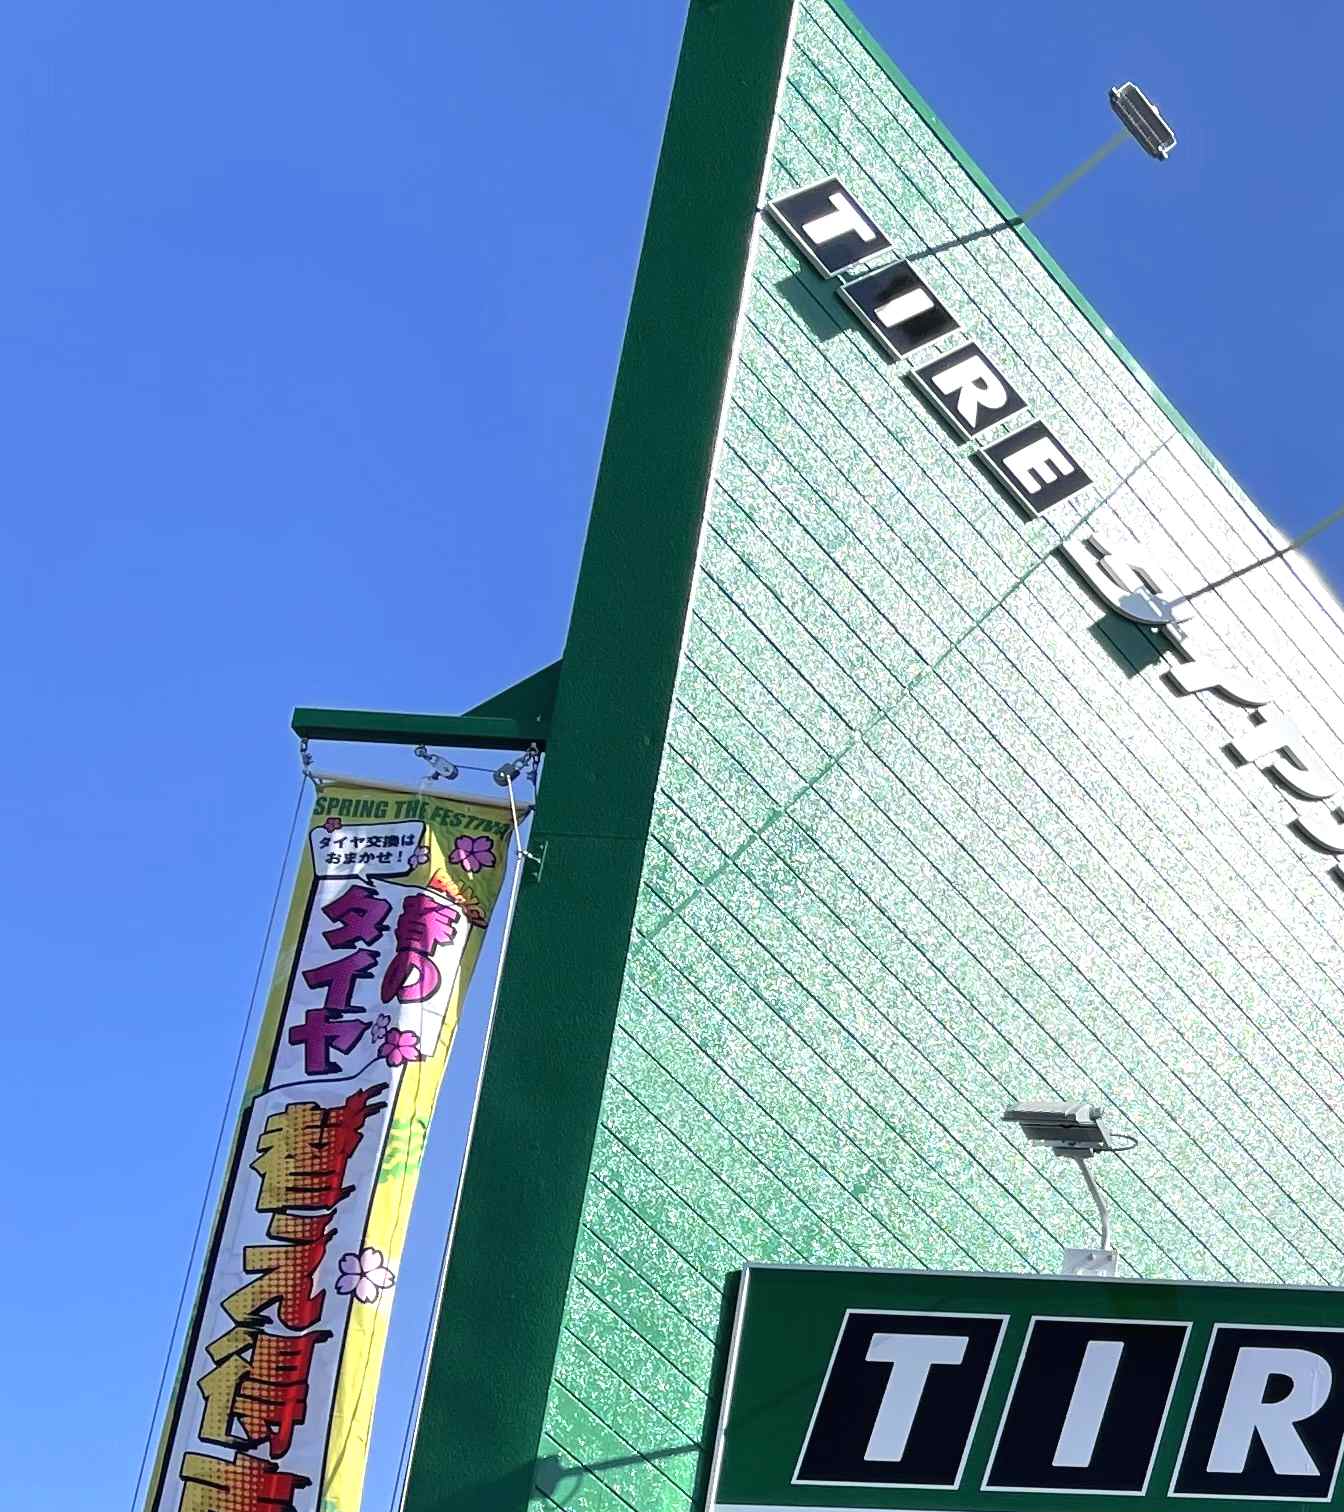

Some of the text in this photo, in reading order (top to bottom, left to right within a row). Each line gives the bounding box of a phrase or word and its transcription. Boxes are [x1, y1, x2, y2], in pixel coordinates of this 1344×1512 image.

[803, 192, 1076, 496] TIRE
[313, 796, 388, 819] SPRING
[394, 799, 430, 820] THE
[319, 833, 416, 850] タイヤ交換は
[325, 851, 403, 864] おまかせ！
[287, 884, 393, 1076] タイヤ
[381, 892, 461, 1004] 春の
